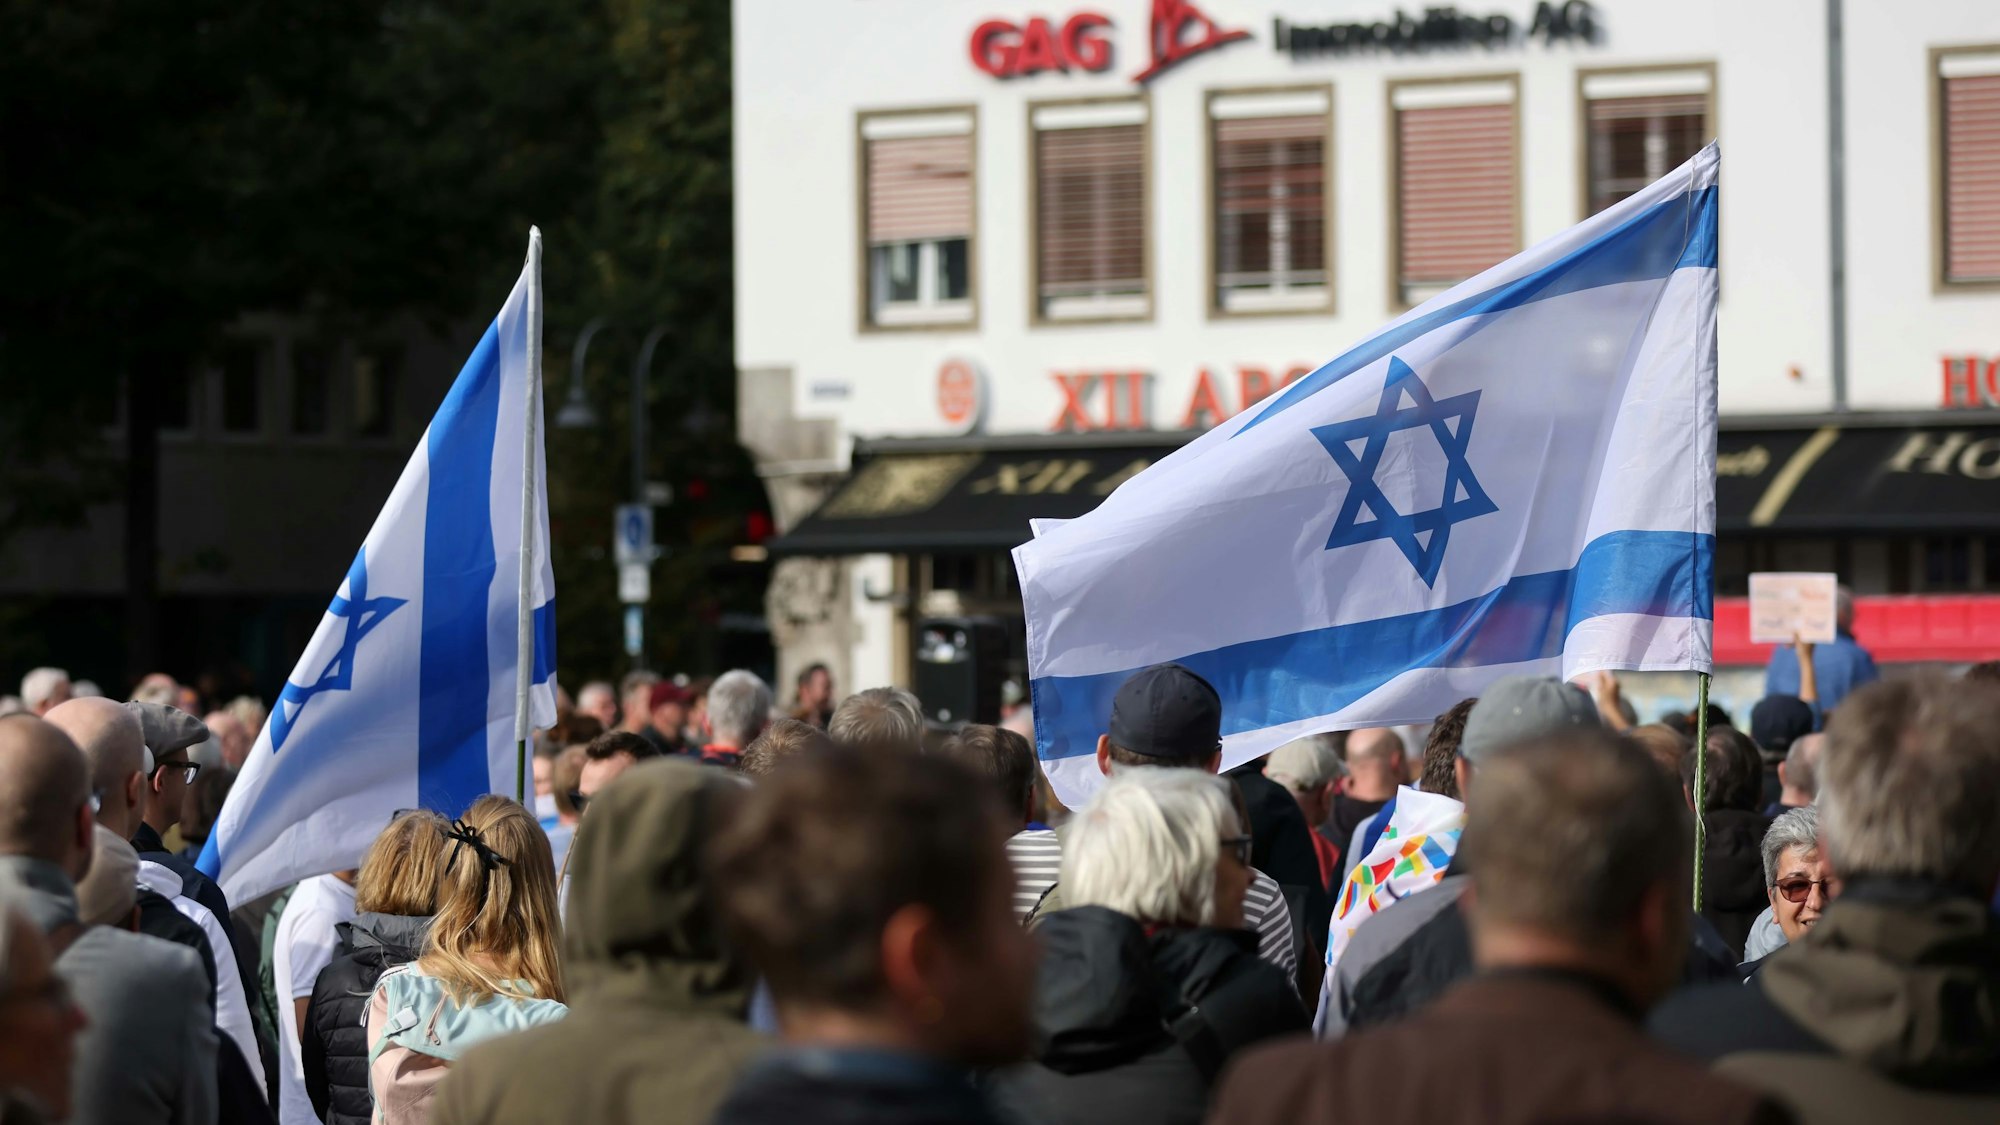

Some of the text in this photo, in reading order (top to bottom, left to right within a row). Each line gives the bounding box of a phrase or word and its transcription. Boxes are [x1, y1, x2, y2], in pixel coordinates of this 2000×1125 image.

[969, 13, 1111, 77] GAG
[1530, 0, 1600, 44] AG
[1050, 369, 1147, 431] XII
